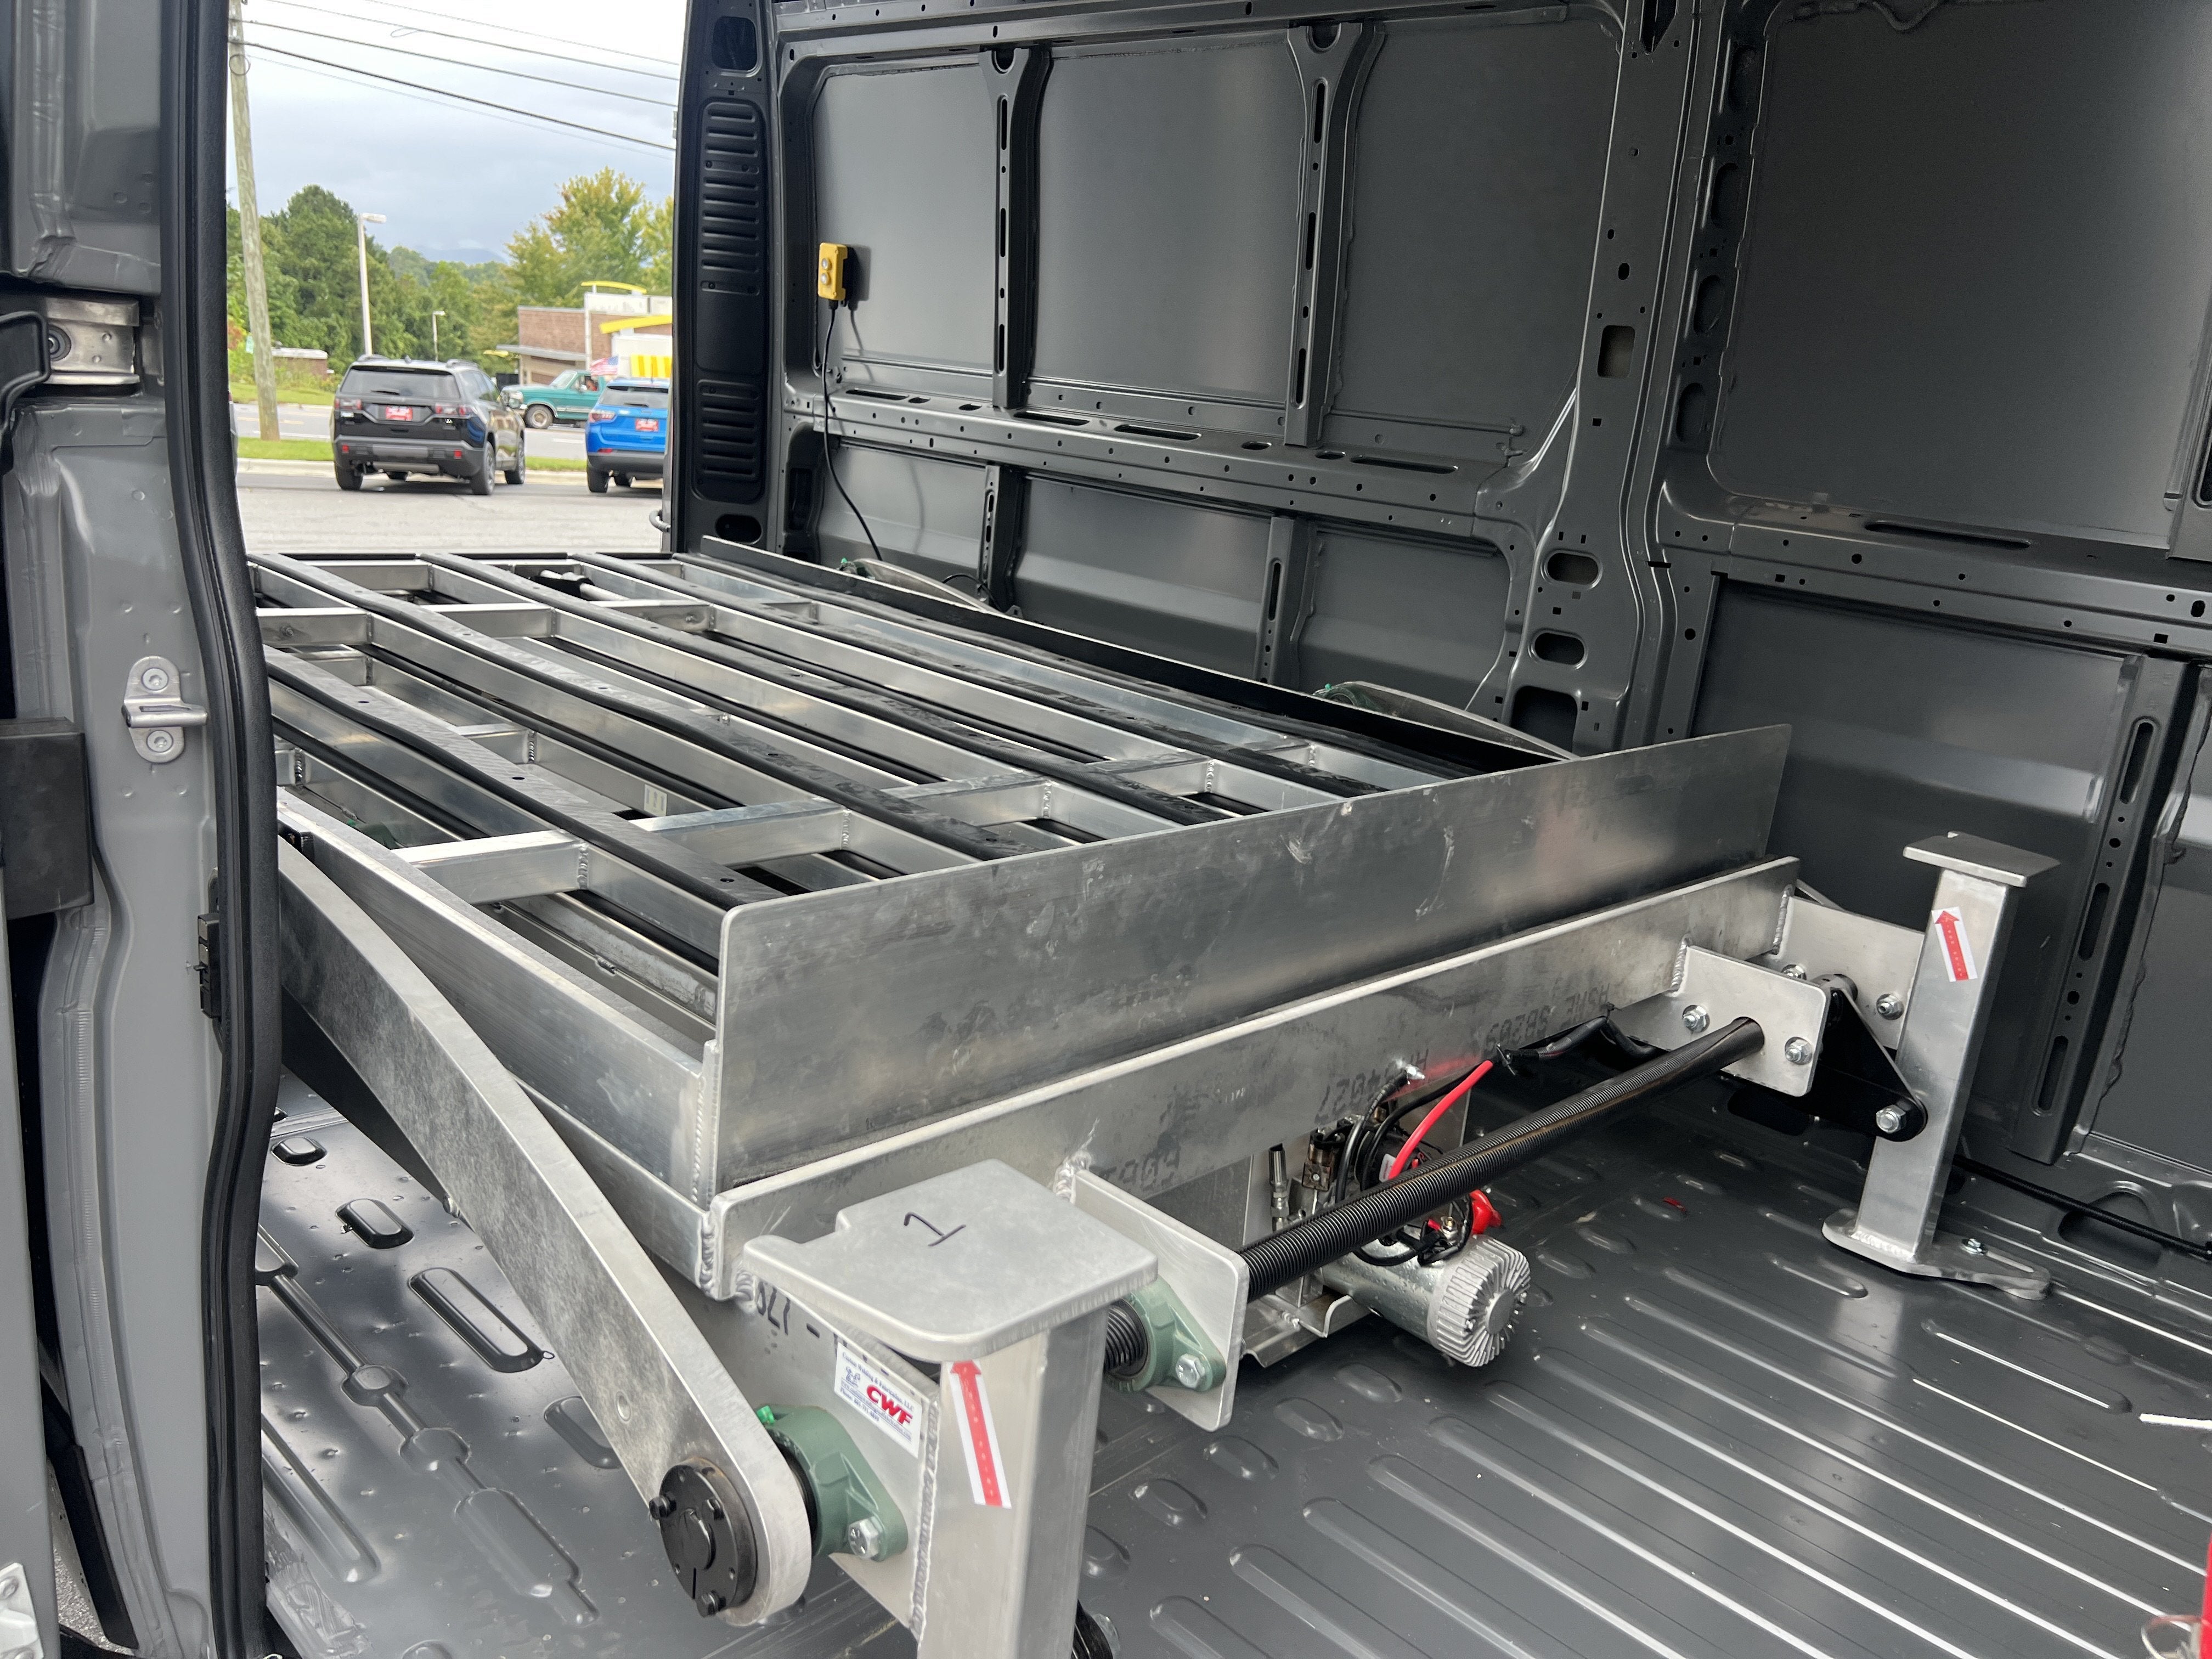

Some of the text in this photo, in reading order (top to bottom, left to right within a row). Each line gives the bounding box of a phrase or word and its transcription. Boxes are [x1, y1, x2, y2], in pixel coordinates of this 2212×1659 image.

[858, 1364, 874, 1382] Welding
[904, 1399, 915, 1412] LLC
[866, 1384, 913, 1425] CWF
